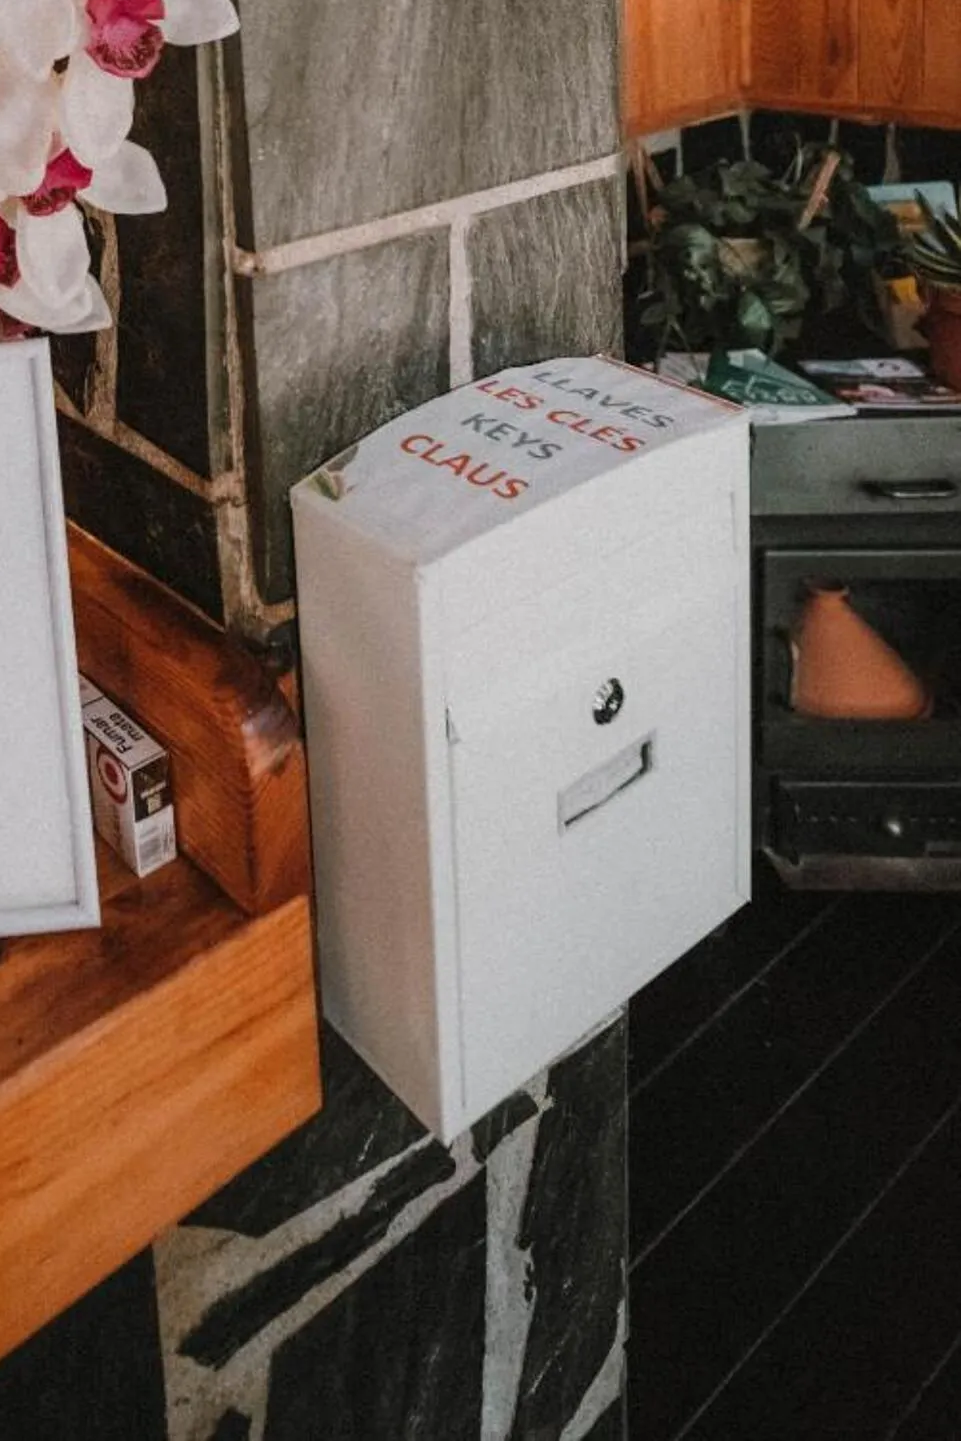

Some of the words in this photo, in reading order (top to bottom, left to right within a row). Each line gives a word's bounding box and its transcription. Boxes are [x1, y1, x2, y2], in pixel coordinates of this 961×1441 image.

[475, 378, 546, 412] LES
[531, 370, 676, 430] LLAVES
[460, 412, 563, 460] KEYS
[400, 432, 529, 501] CLAUS
[90, 715, 134, 755] Fumar
[109, 710, 145, 743] mata
